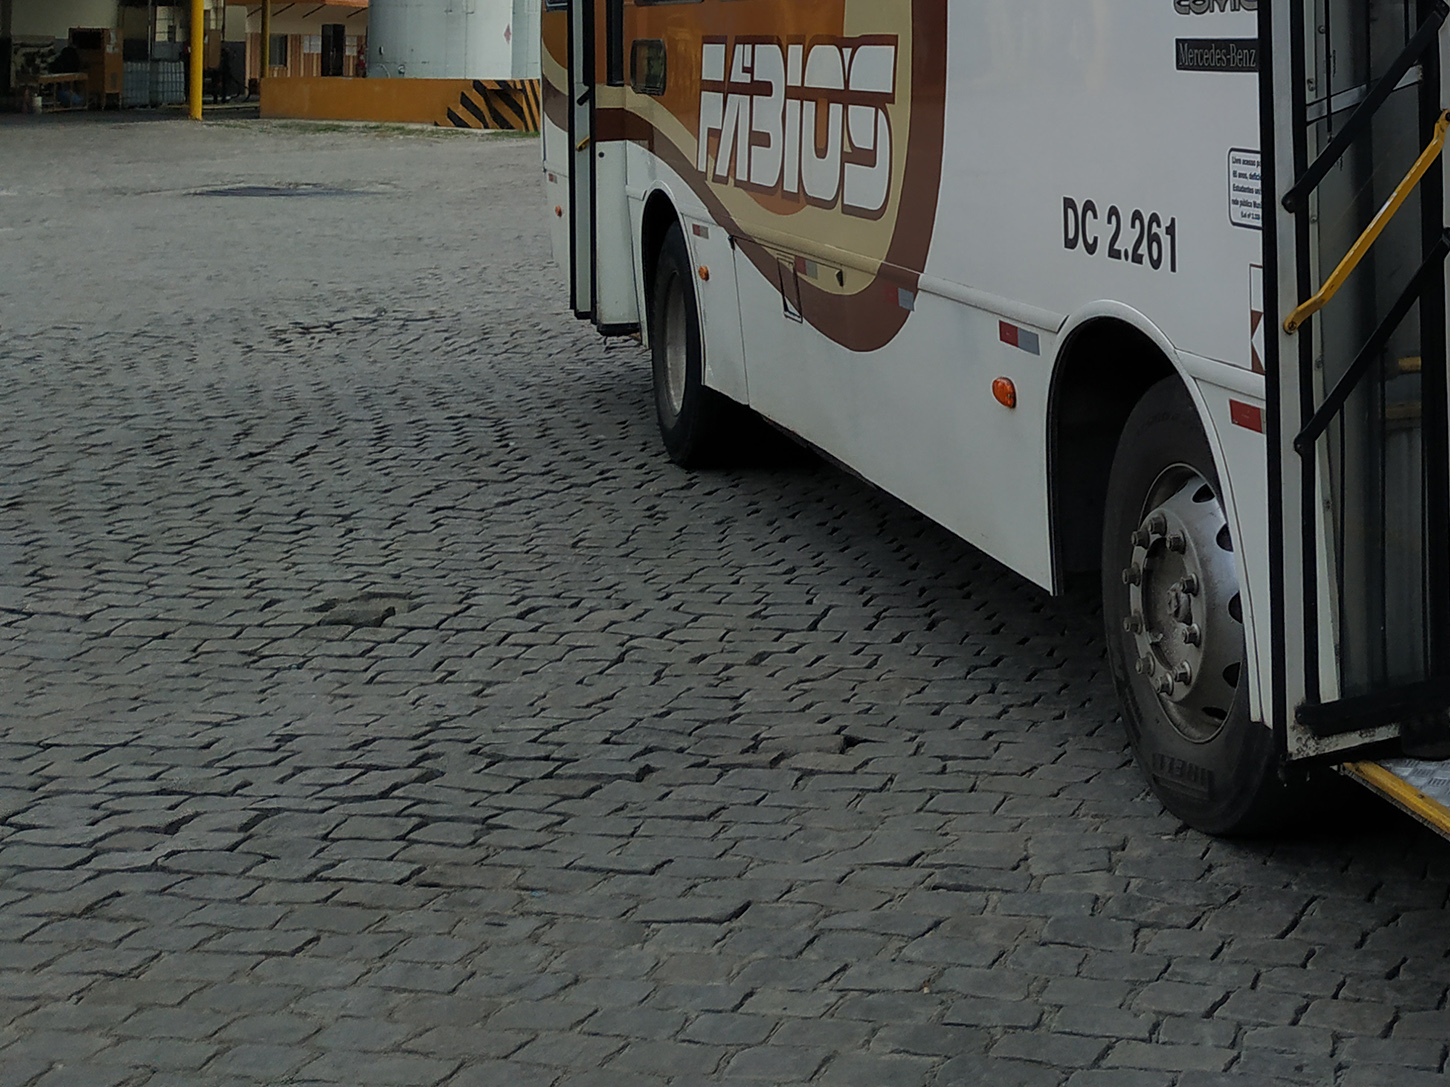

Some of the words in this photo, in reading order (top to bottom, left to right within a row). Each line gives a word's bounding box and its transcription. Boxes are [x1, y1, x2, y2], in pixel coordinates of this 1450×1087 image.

[1178, 42, 1257, 67] Mercedes-Benz
[1063, 196, 1099, 255] DC
[1107, 205, 1176, 273] 2.261
